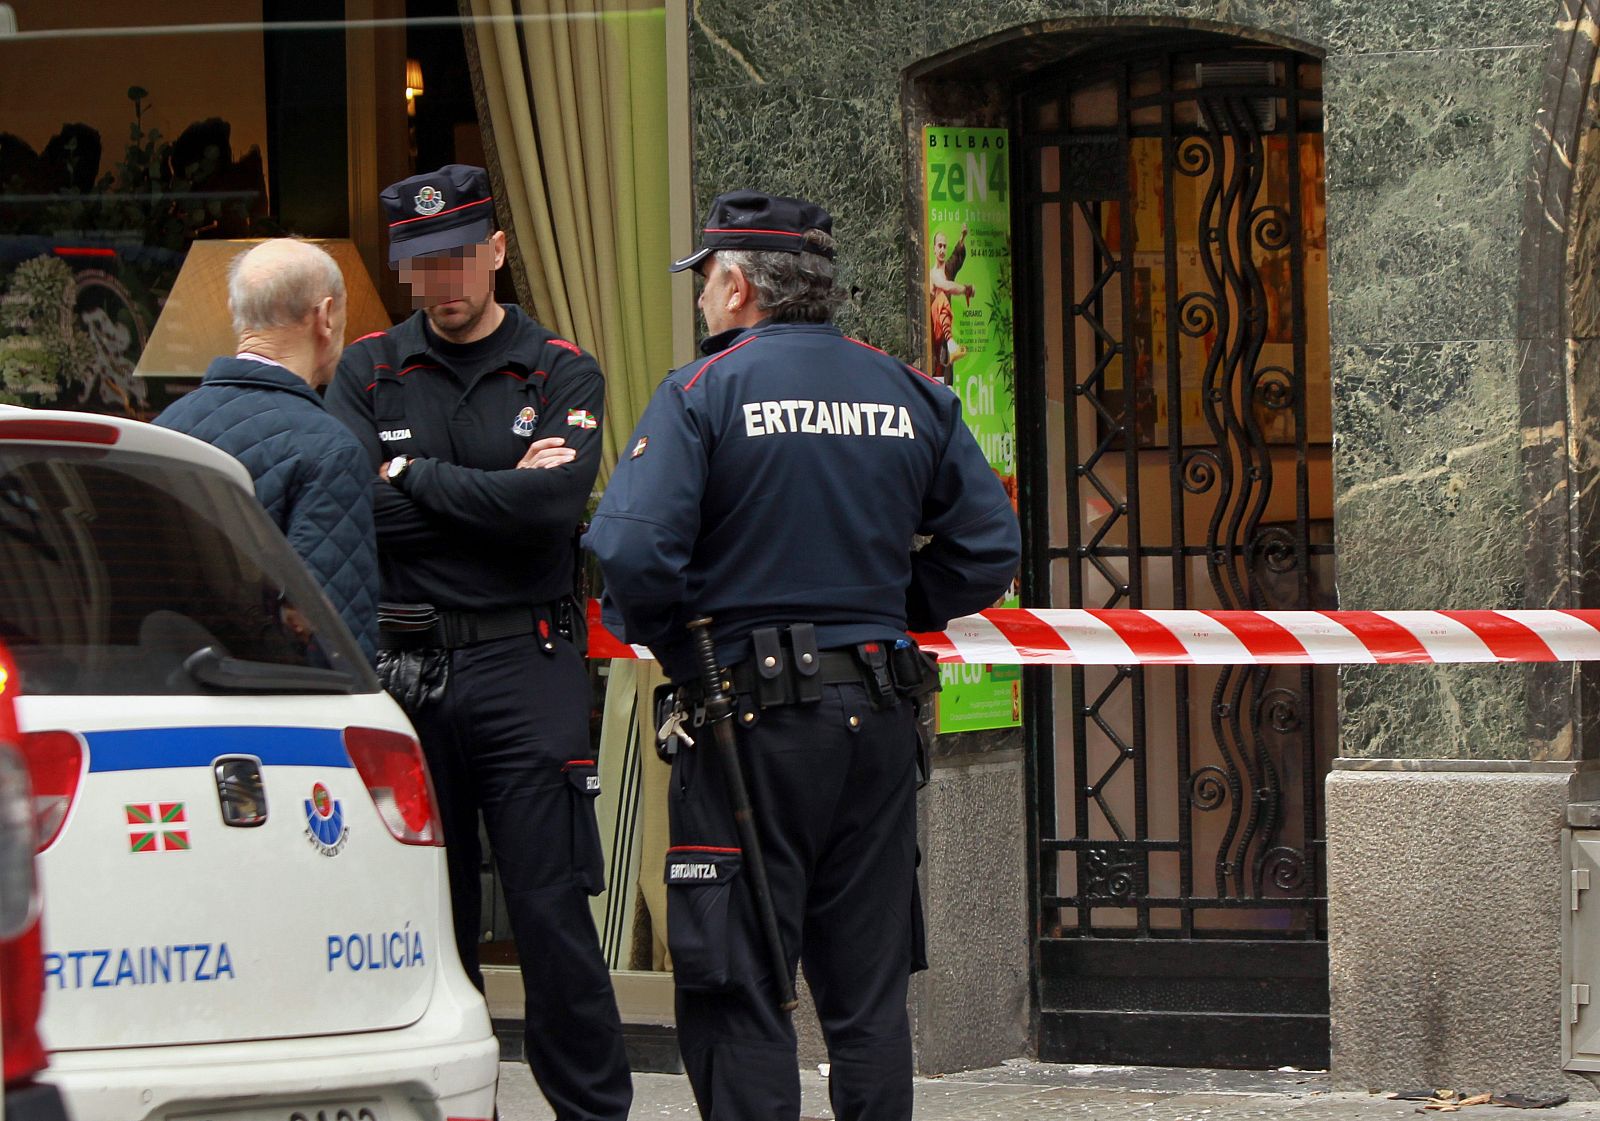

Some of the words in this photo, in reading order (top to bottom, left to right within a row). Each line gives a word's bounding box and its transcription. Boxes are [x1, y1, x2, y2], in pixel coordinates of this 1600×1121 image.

[929, 134, 1005, 149] BILBAO
[931, 207, 960, 222] Salud
[966, 375, 994, 416] Chi
[742, 400, 915, 439] ERTZAINTZA
[43, 942, 236, 990] RTZAINTZA
[327, 921, 425, 972] POLICÍA
